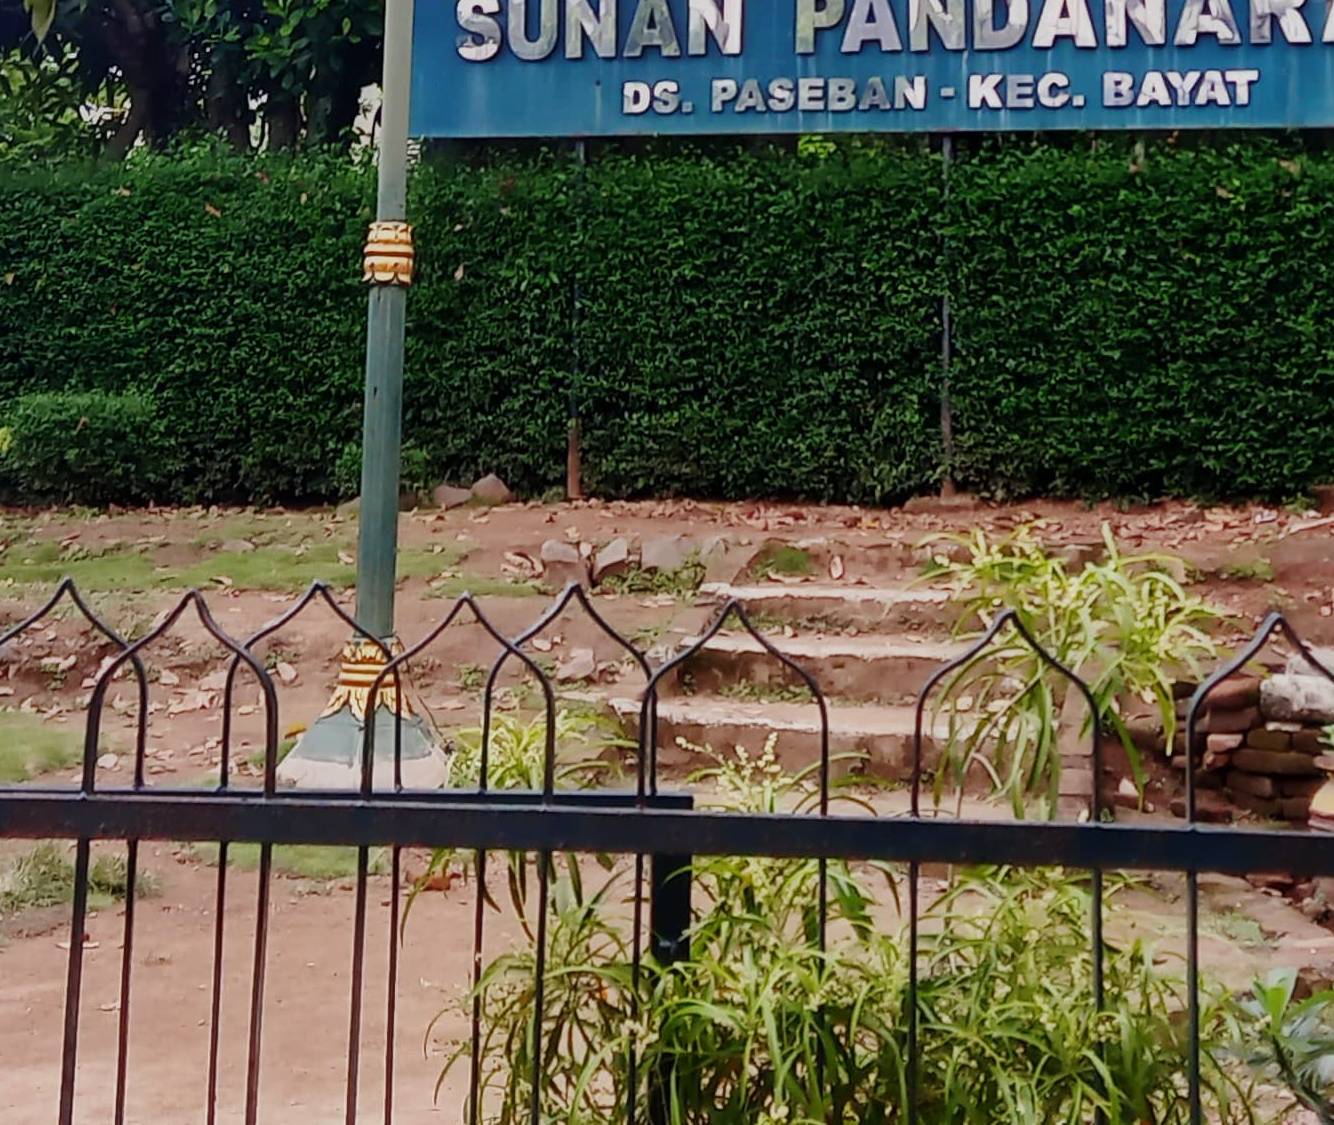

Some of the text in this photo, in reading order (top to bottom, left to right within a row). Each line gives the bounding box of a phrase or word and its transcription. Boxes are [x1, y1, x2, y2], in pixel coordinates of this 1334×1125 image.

[623, 81, 694, 115] DS.
[710, 76, 928, 113] PASEBAN
[968, 72, 1087, 110] KEC.
[1102, 69, 1261, 109] BAYAT
